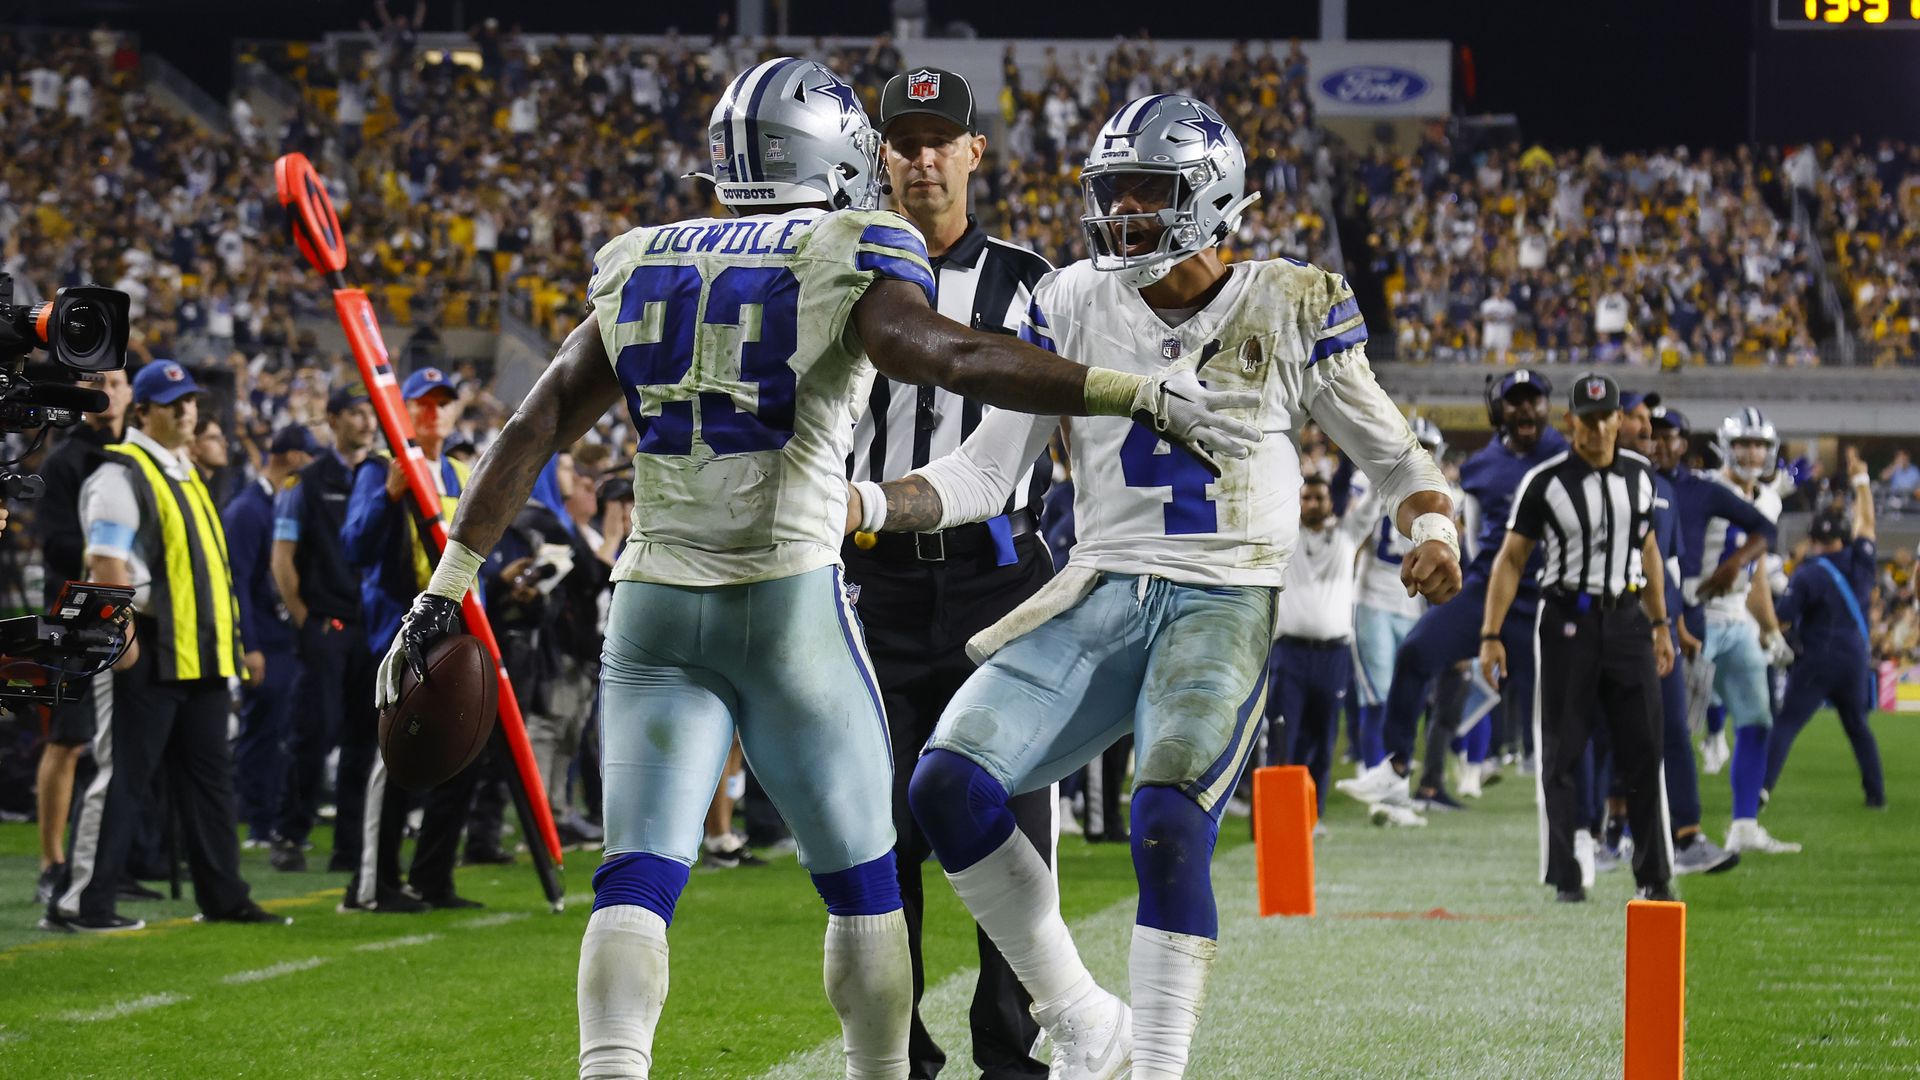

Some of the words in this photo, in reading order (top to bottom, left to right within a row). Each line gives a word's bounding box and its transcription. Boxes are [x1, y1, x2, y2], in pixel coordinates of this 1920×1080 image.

[911, 82, 938, 97] NFL
[1338, 69, 1407, 100] Ford
[723, 188, 776, 200] COWBOYS
[645, 219, 812, 255] DOWDLE
[615, 264, 800, 455] 23
[1119, 381, 1217, 535] 4
